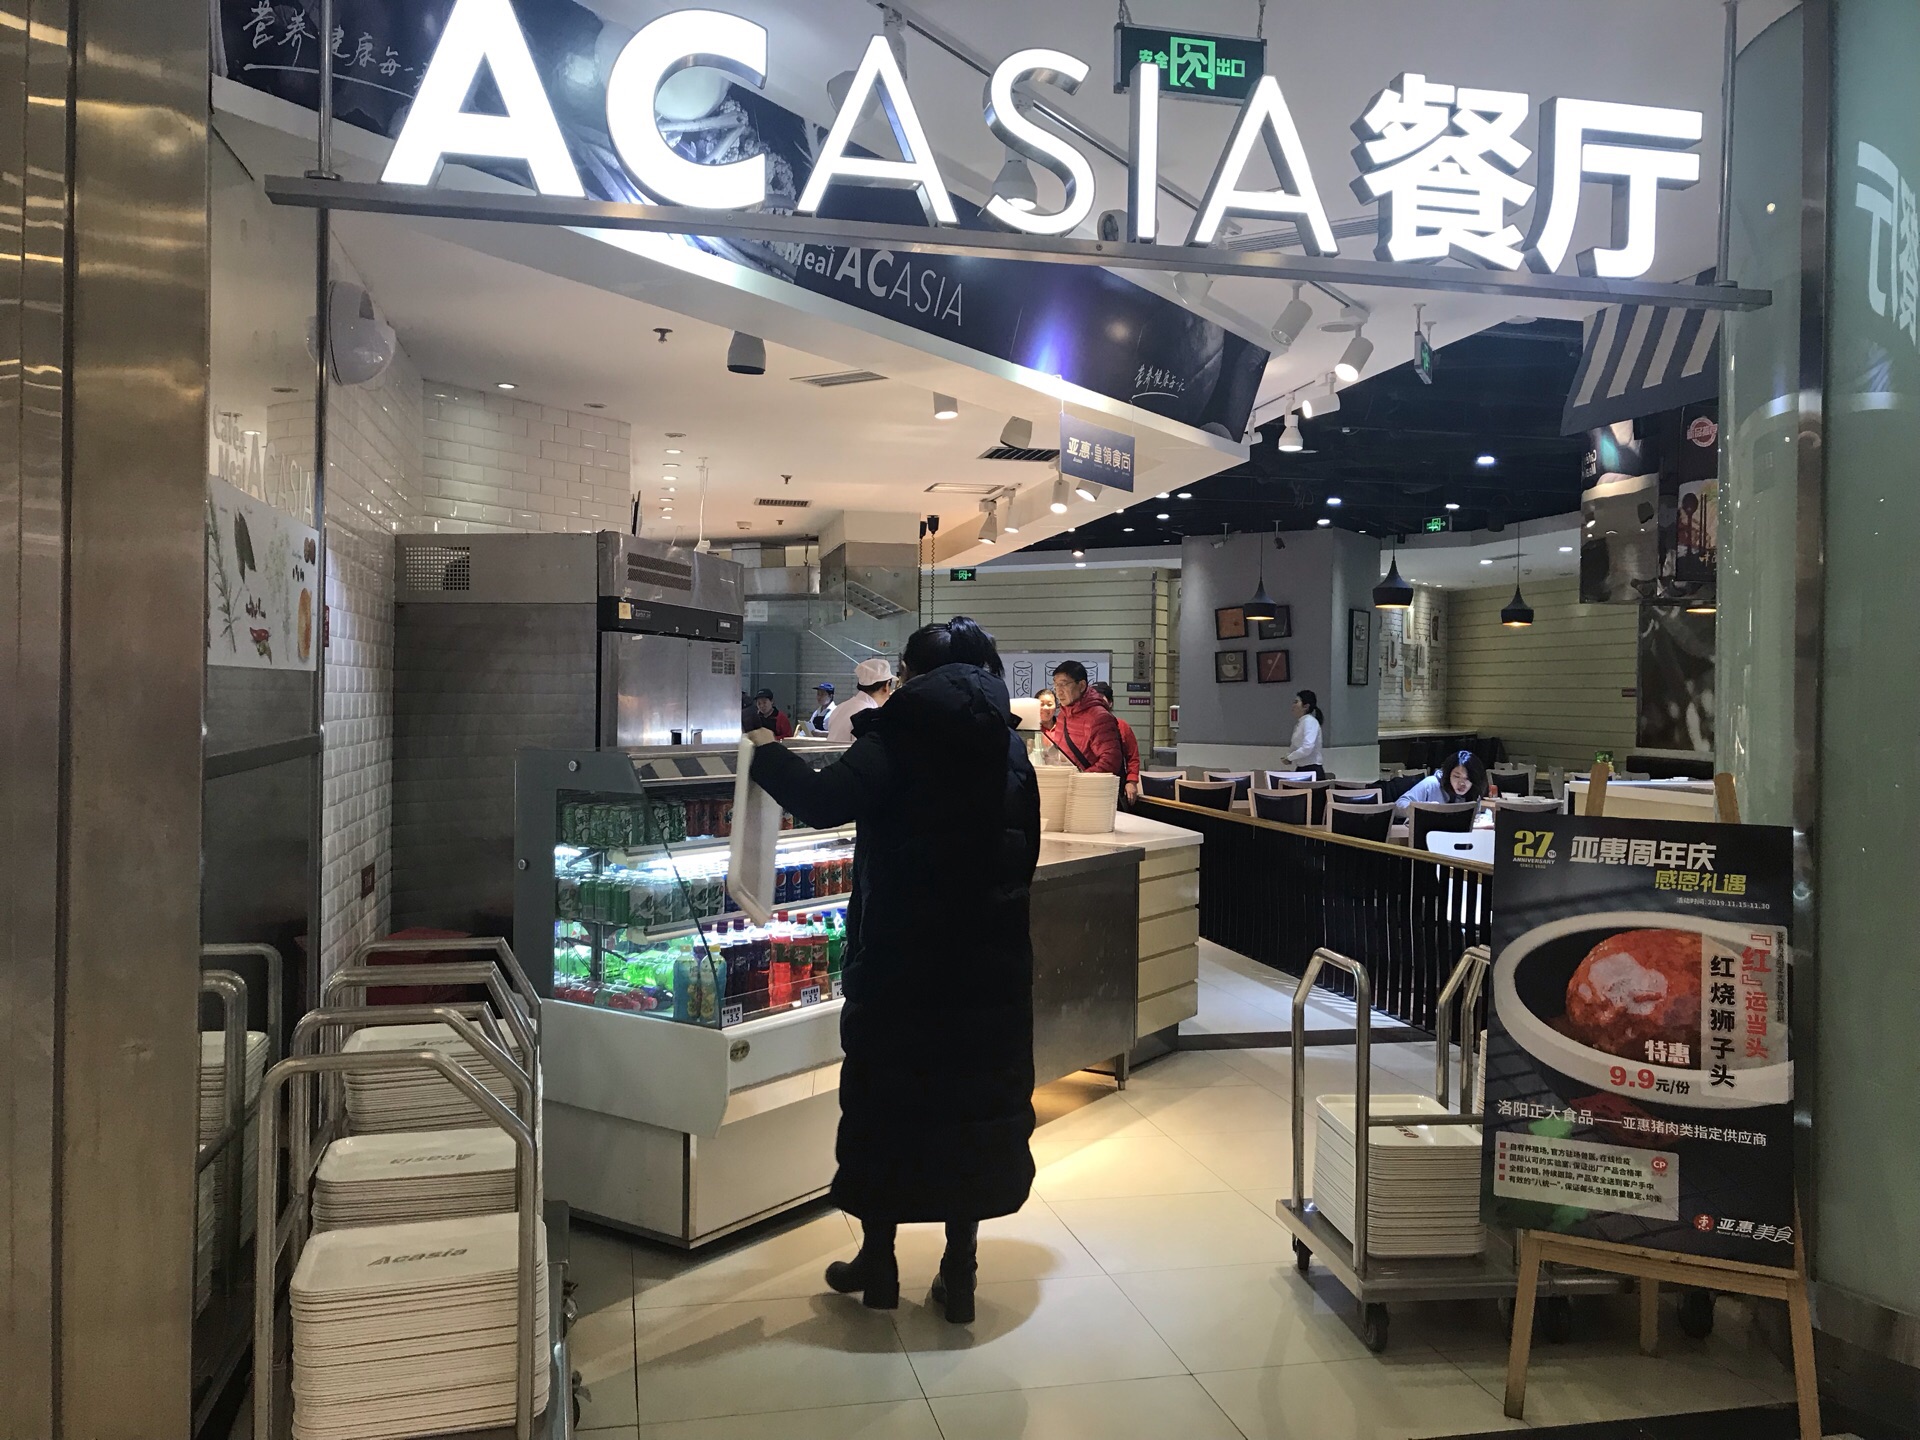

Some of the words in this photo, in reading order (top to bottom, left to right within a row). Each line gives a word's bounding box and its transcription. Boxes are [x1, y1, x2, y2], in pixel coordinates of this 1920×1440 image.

[1139, 49, 1169, 69] 安全
[1216, 58, 1245, 77] 出口
[382, 0, 1337, 258] ACASIA
[1353, 72, 1704, 280] 餐厅
[785, 242, 835, 277] Meal
[834, 246, 962, 327] ACASIA
[1513, 830, 1555, 858] 27
[1569, 835, 1717, 871] 亚惠周年庆
[1512, 857, 1556, 865] ANNIVERSARY
[1655, 870, 1747, 896] 感恩礼遇
[1710, 955, 1736, 1088] 红烧狮子头
[1645, 1040, 1691, 1065] 特惠
[1653, 1160, 1666, 1169] CP
[367, 1248, 468, 1268] Acasia
